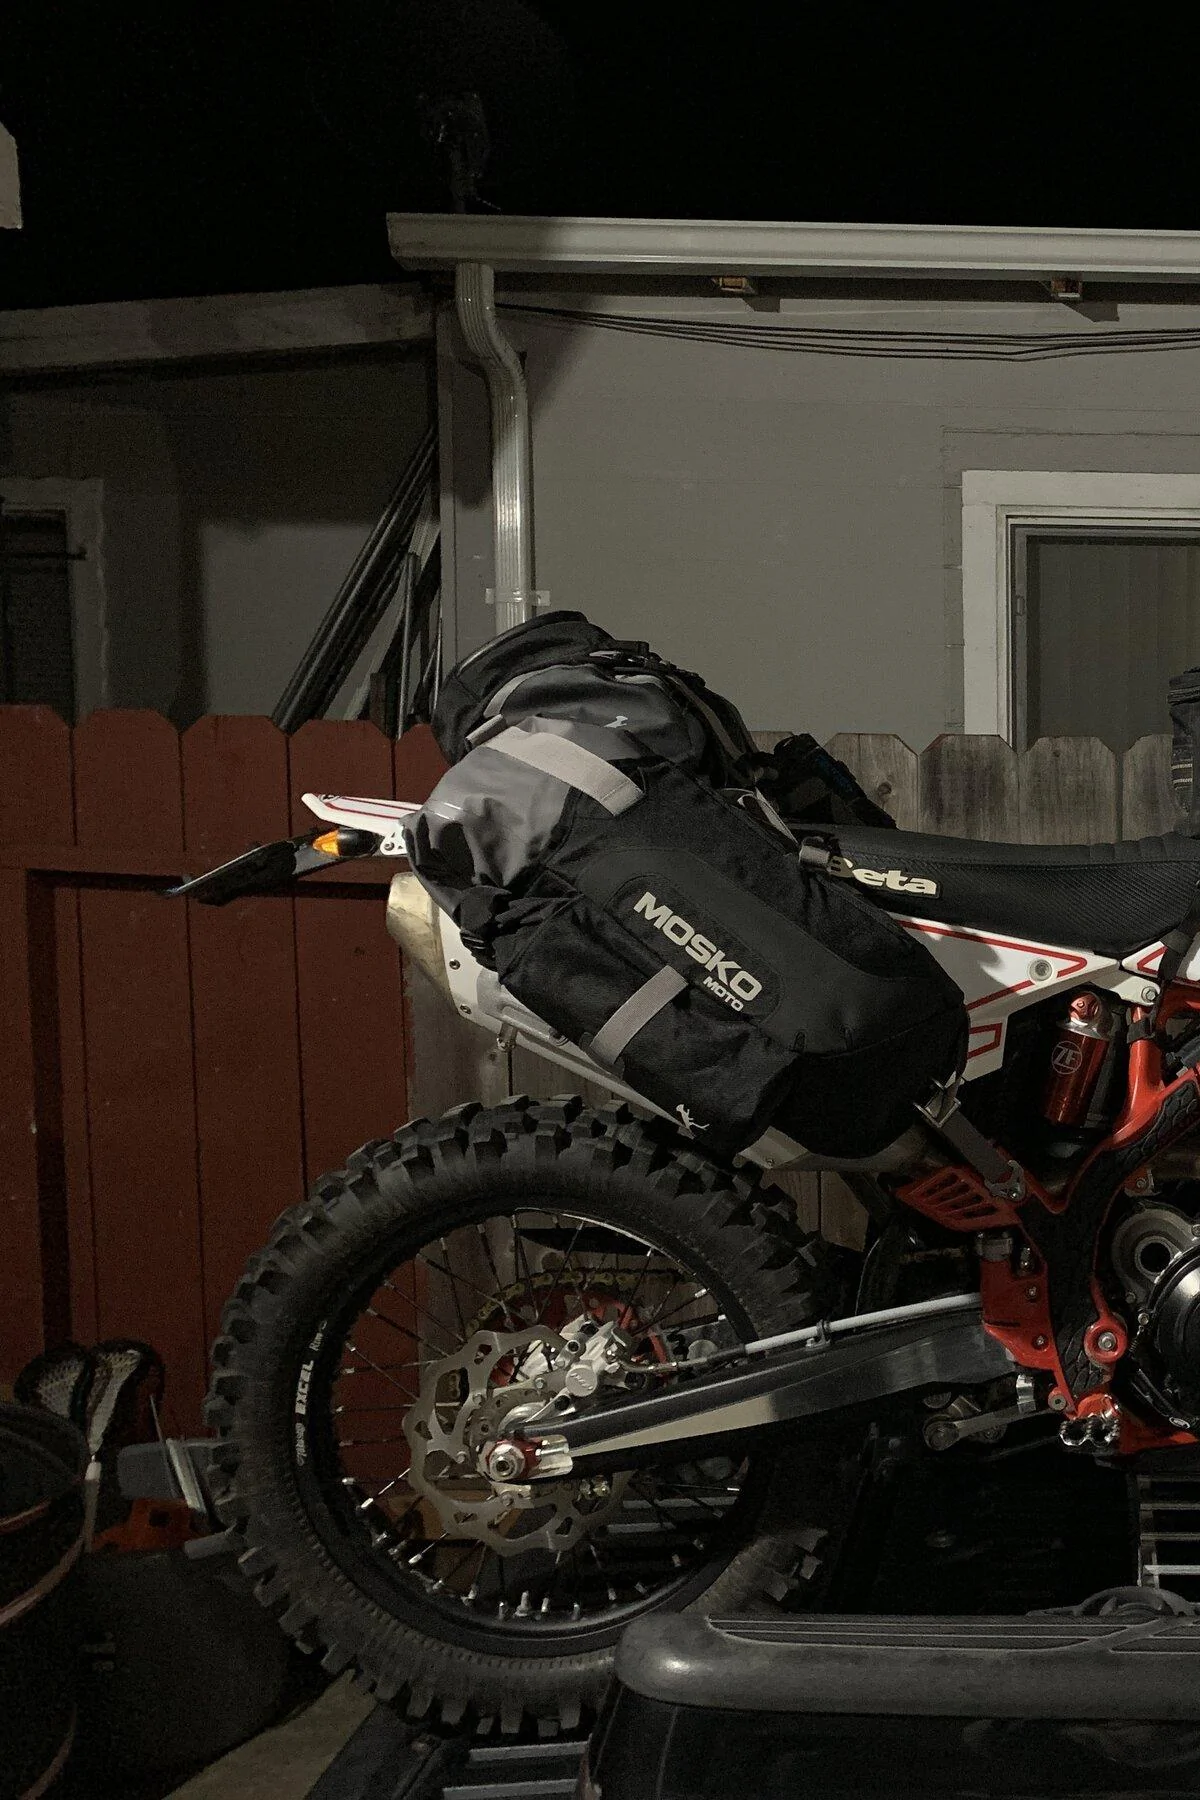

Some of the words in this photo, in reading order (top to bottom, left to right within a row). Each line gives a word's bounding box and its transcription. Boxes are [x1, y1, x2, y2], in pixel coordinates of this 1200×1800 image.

[842, 857, 938, 895] eta
[633, 891, 763, 1001] MOSKO
[702, 976, 744, 1012] MOTO
[1052, 1044, 1082, 1071] ZF
[295, 1360, 315, 1415] EXCEL
